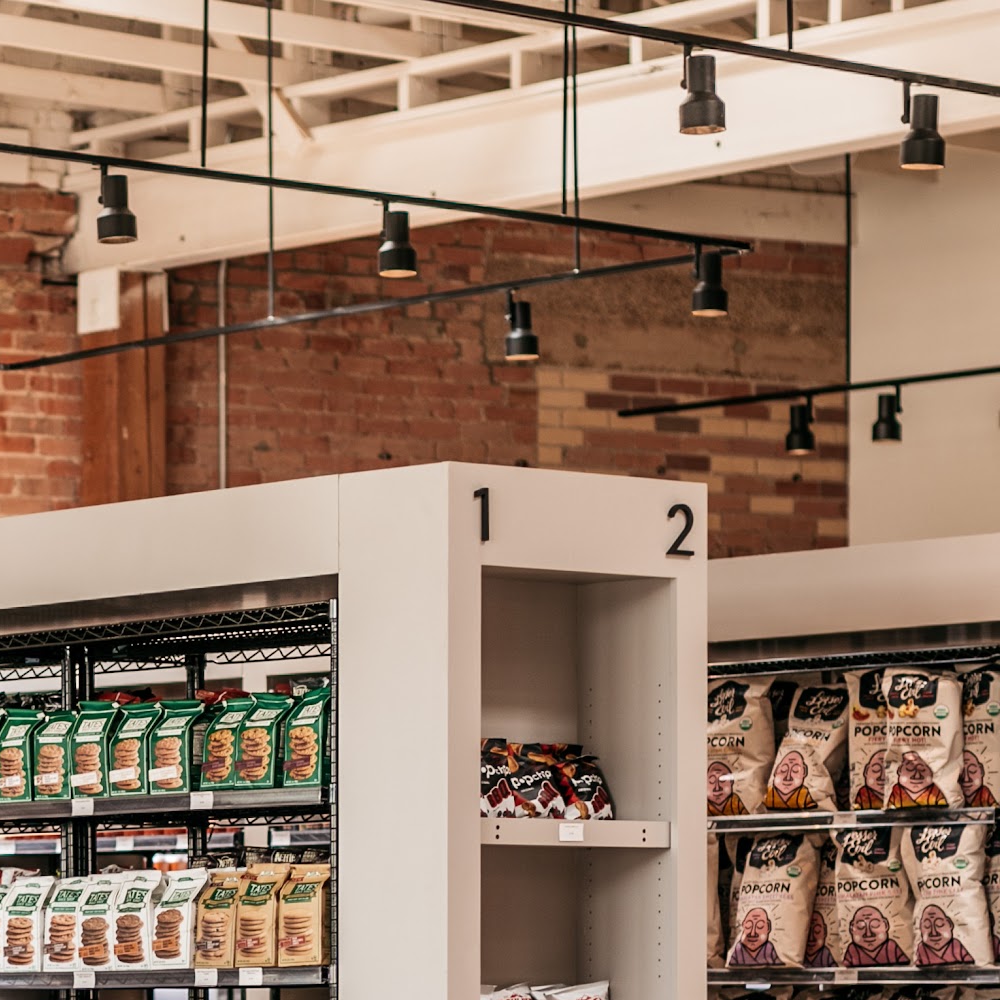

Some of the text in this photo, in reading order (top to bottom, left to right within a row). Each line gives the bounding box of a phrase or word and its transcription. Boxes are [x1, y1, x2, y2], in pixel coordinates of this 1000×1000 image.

[474, 488, 489, 541] 1
[666, 504, 694, 556] 2
[854, 725, 887, 737] POPC
[963, 723, 995, 735] CORN
[707, 737, 745, 748] PCORN
[741, 882, 791, 895] POPCORN
[837, 877, 900, 891] POPCORN
